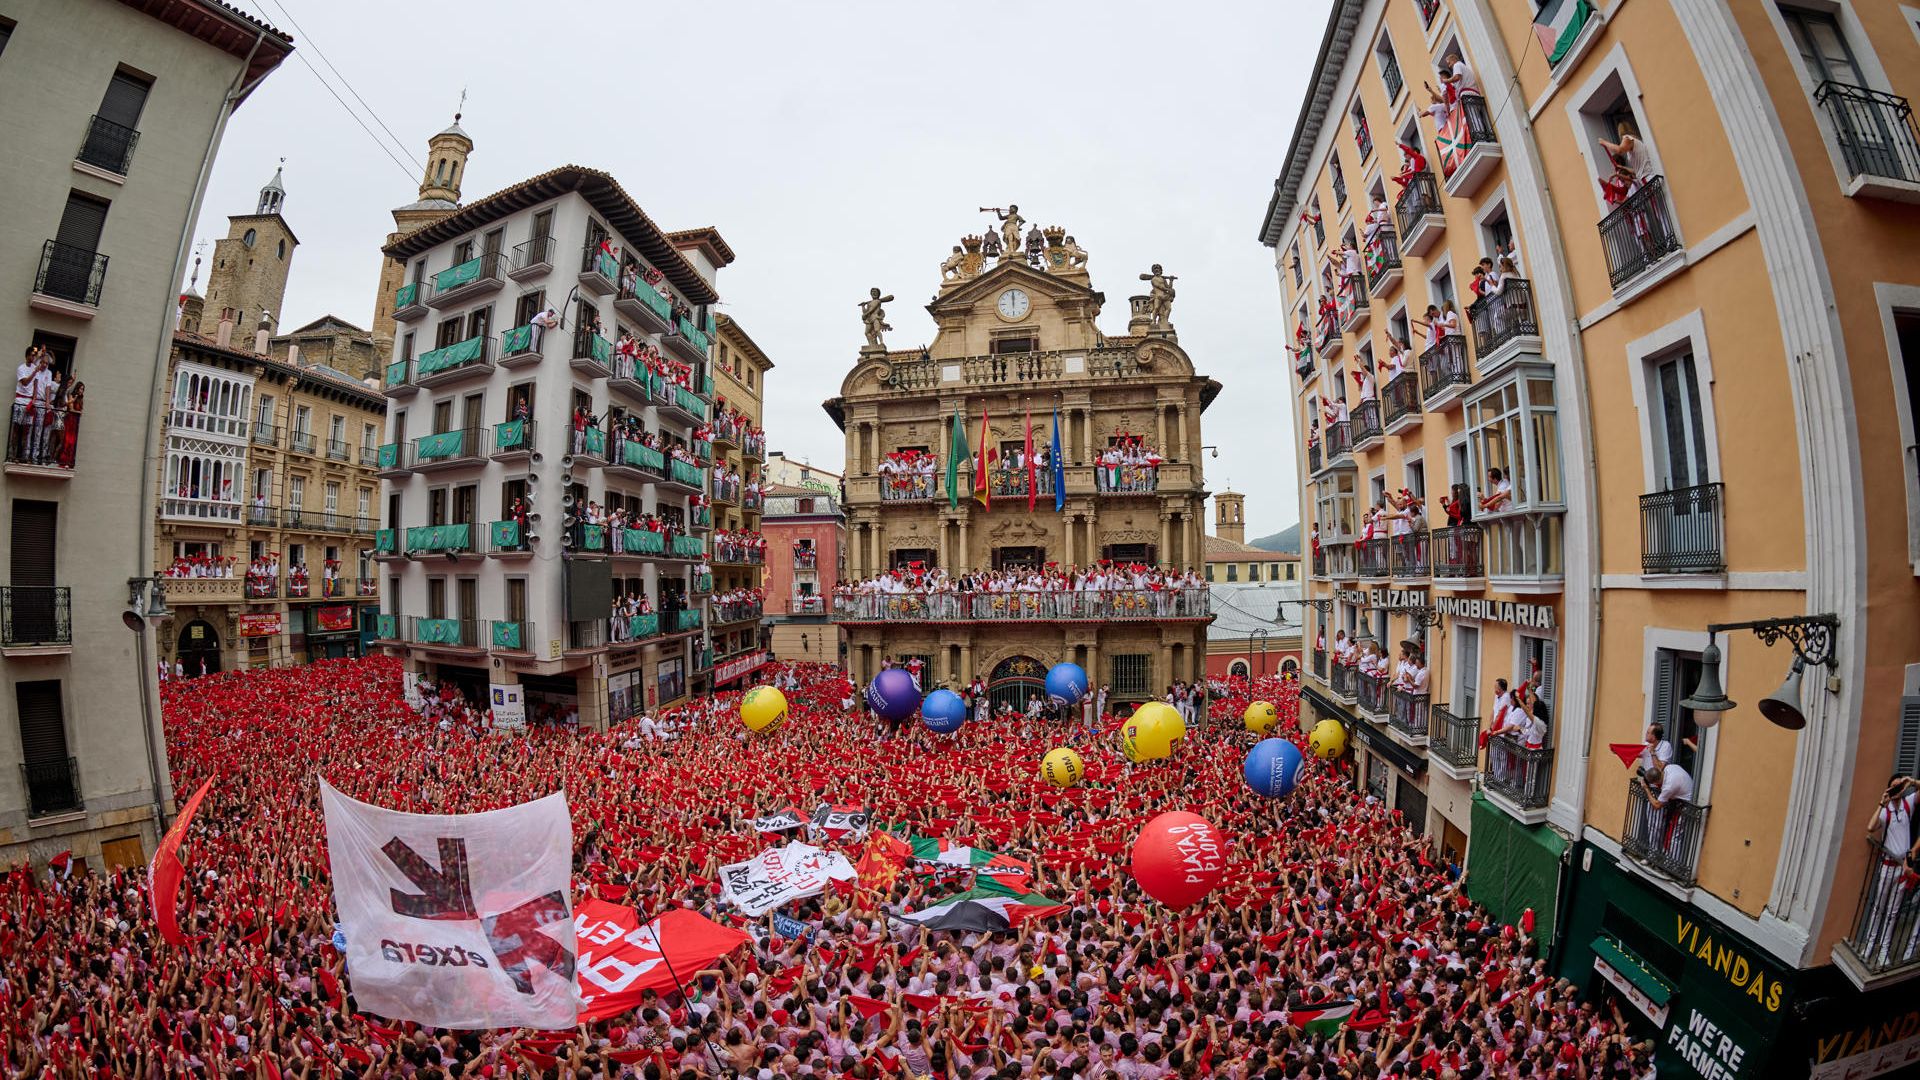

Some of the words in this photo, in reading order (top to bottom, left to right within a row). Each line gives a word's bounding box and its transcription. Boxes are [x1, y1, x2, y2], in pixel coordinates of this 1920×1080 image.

[1334, 589, 1365, 605] AGENCIA
[1371, 588, 1425, 608] ELIZARI
[1435, 596, 1549, 629] INMOBILIARIA
[1175, 834, 1204, 883] PLATA
[1188, 823, 1221, 872] PLOMO
[1676, 914, 1783, 1013] VIANDAS
[1688, 1009, 1746, 1072] WE'RE
[1817, 1010, 1920, 1065] VIAND
